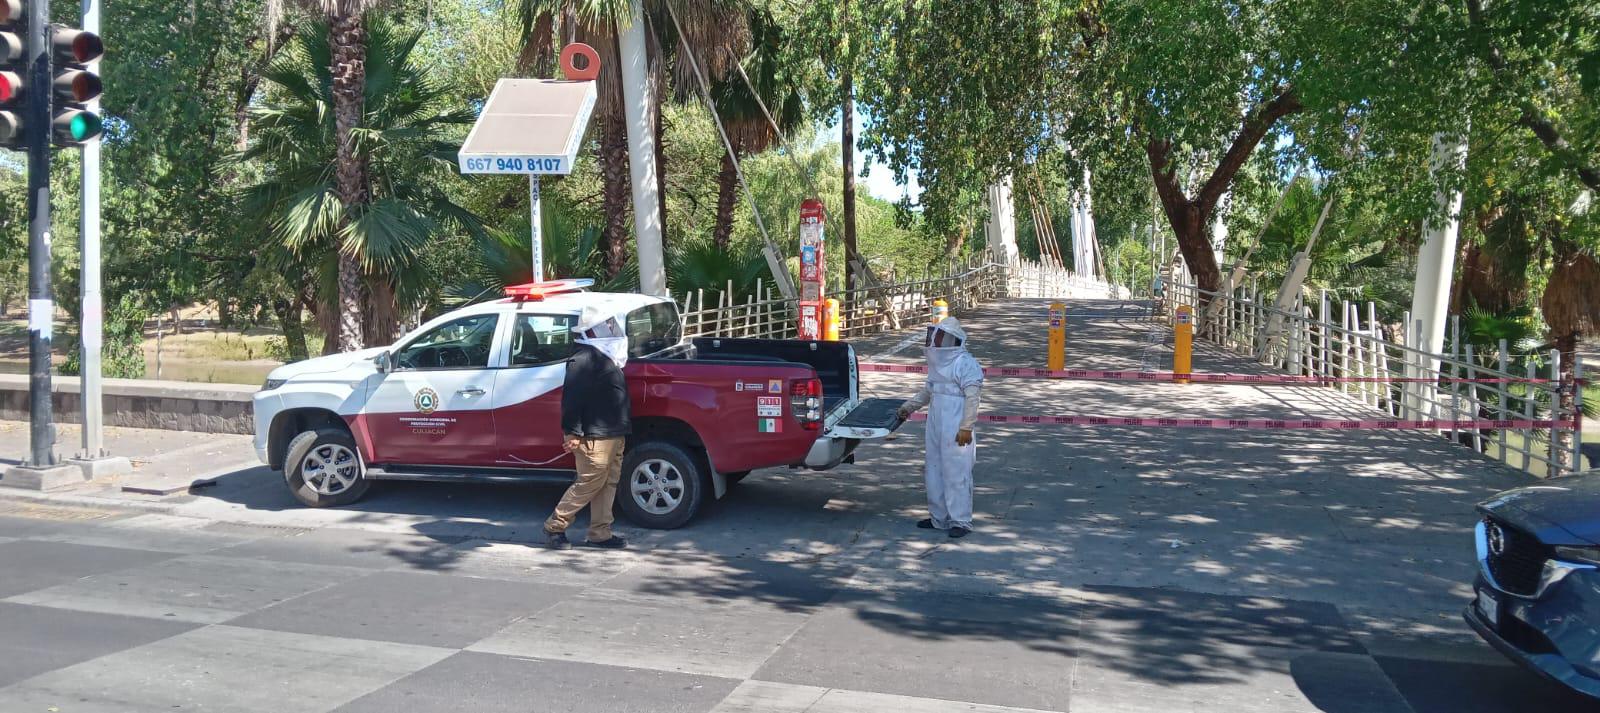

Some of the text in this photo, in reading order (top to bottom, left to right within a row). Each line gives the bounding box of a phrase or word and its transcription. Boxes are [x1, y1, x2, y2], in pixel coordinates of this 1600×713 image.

[467, 158, 561, 171] 667 940 8107
